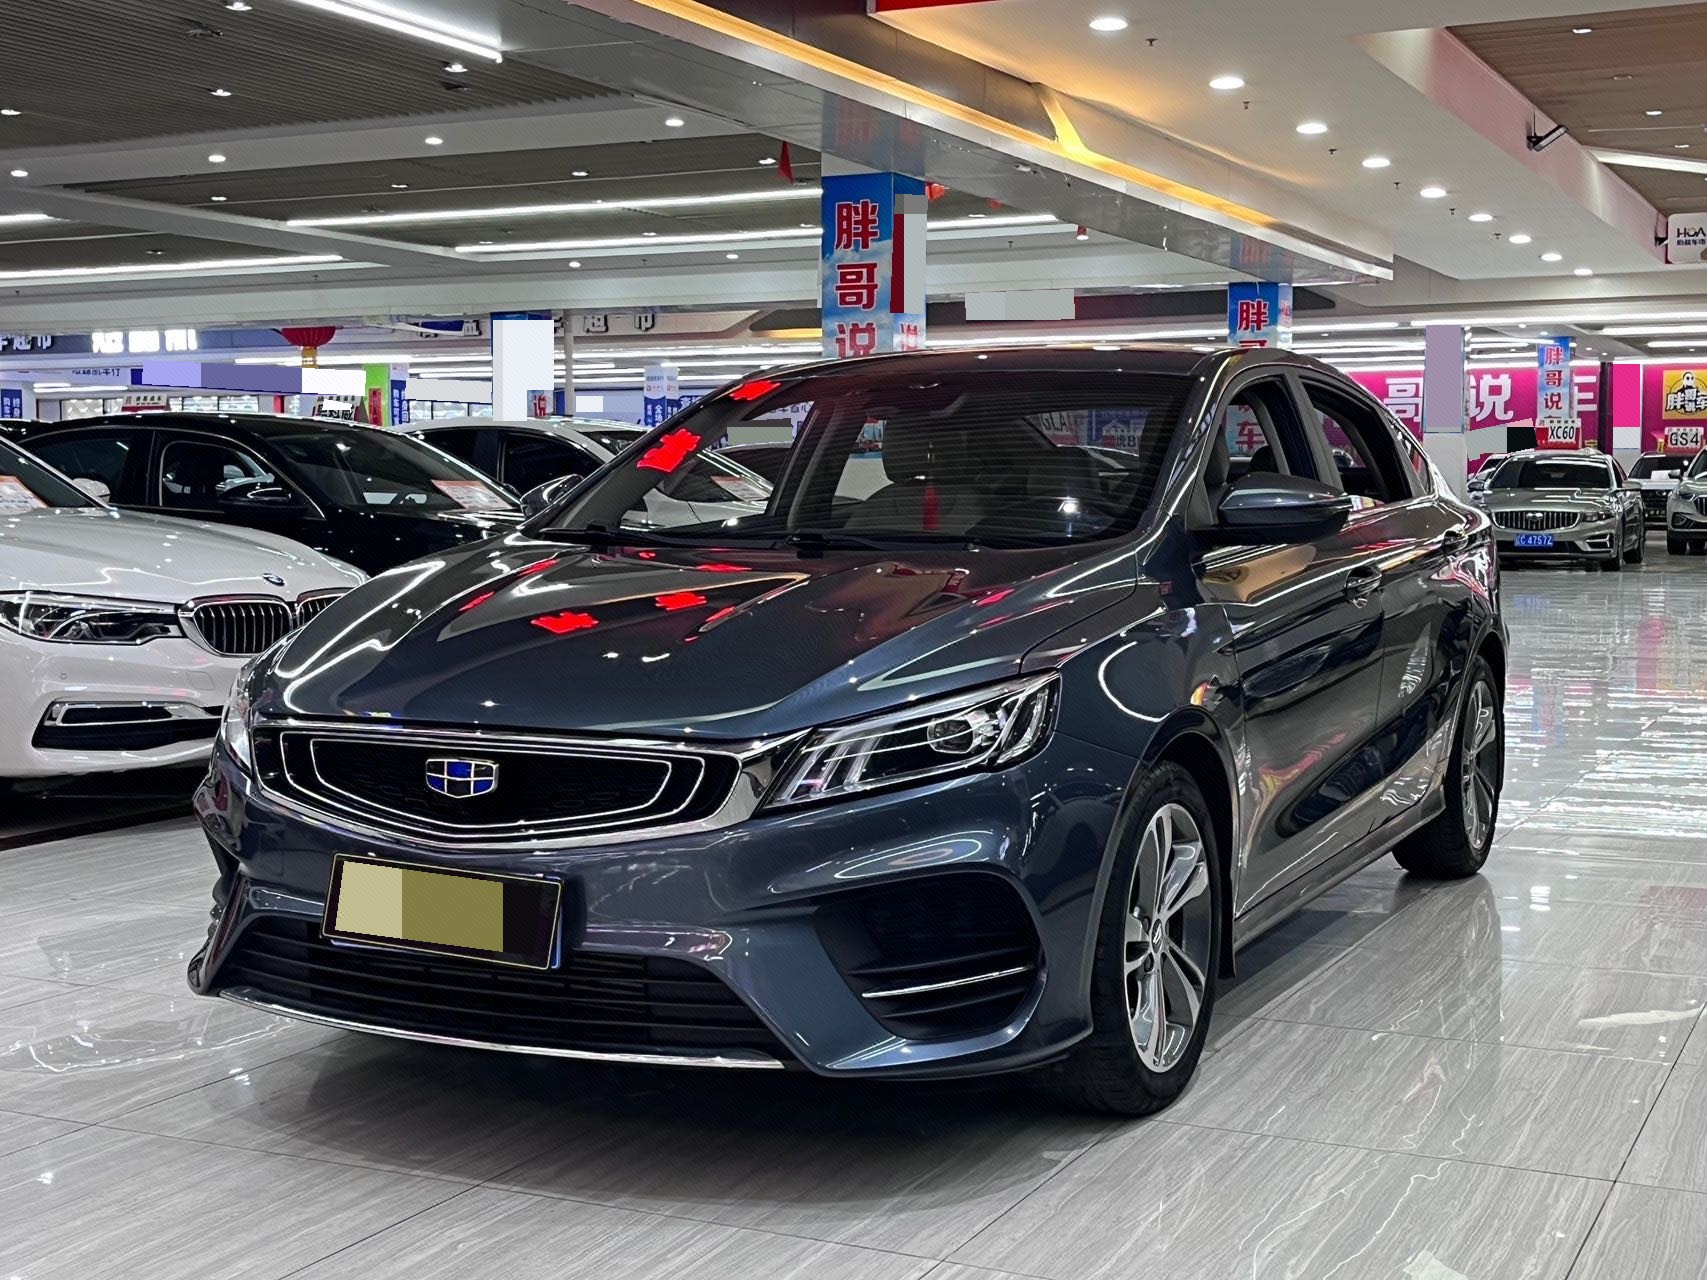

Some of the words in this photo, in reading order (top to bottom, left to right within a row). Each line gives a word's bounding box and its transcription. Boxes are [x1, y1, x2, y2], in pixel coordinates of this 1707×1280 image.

[835, 199, 879, 358] 胖哥说
[1543, 346, 1563, 419] 胖哥说
[1549, 426, 1575, 440] XC60
[1669, 432, 1699, 446] GS4
